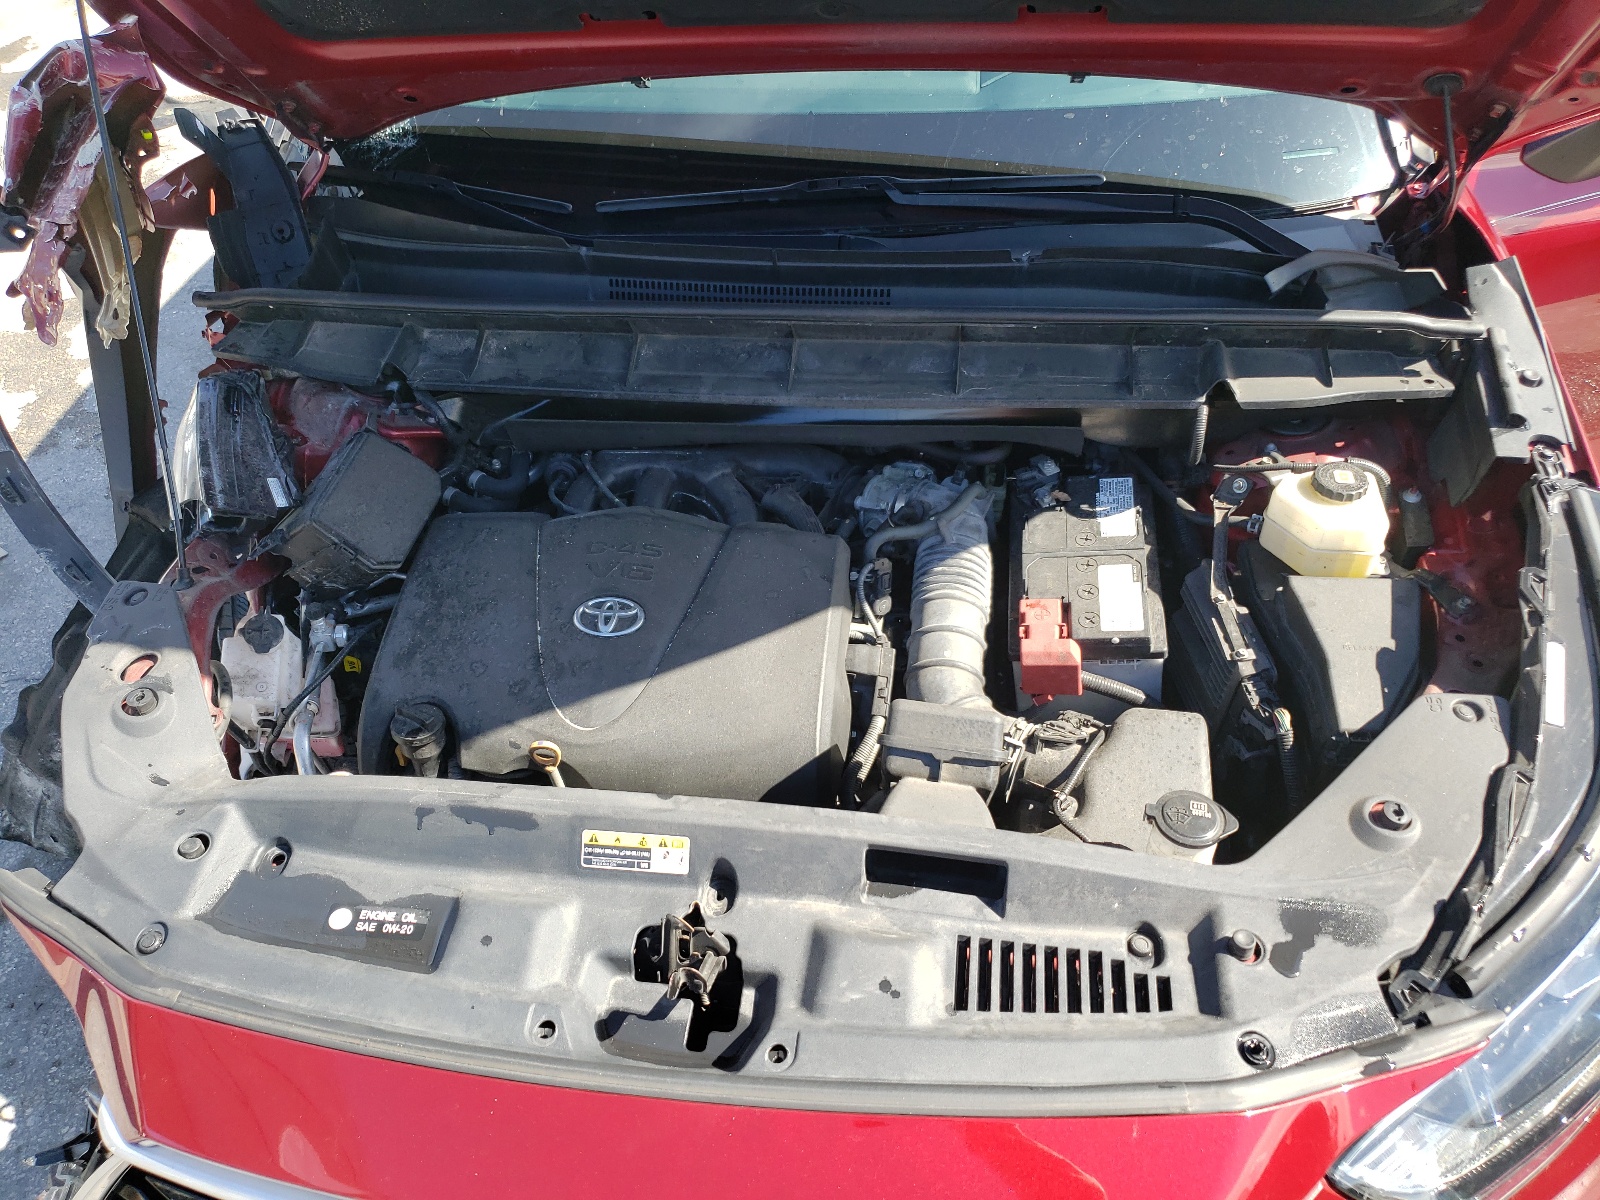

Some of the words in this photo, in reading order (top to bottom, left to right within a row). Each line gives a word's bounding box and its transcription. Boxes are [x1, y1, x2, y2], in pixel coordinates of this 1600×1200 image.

[585, 541, 664, 558] D-4S
[585, 562, 655, 580] V6
[359, 909, 396, 921] ENGINE
[401, 912, 418, 922] OIL
[355, 921, 377, 932] SAE
